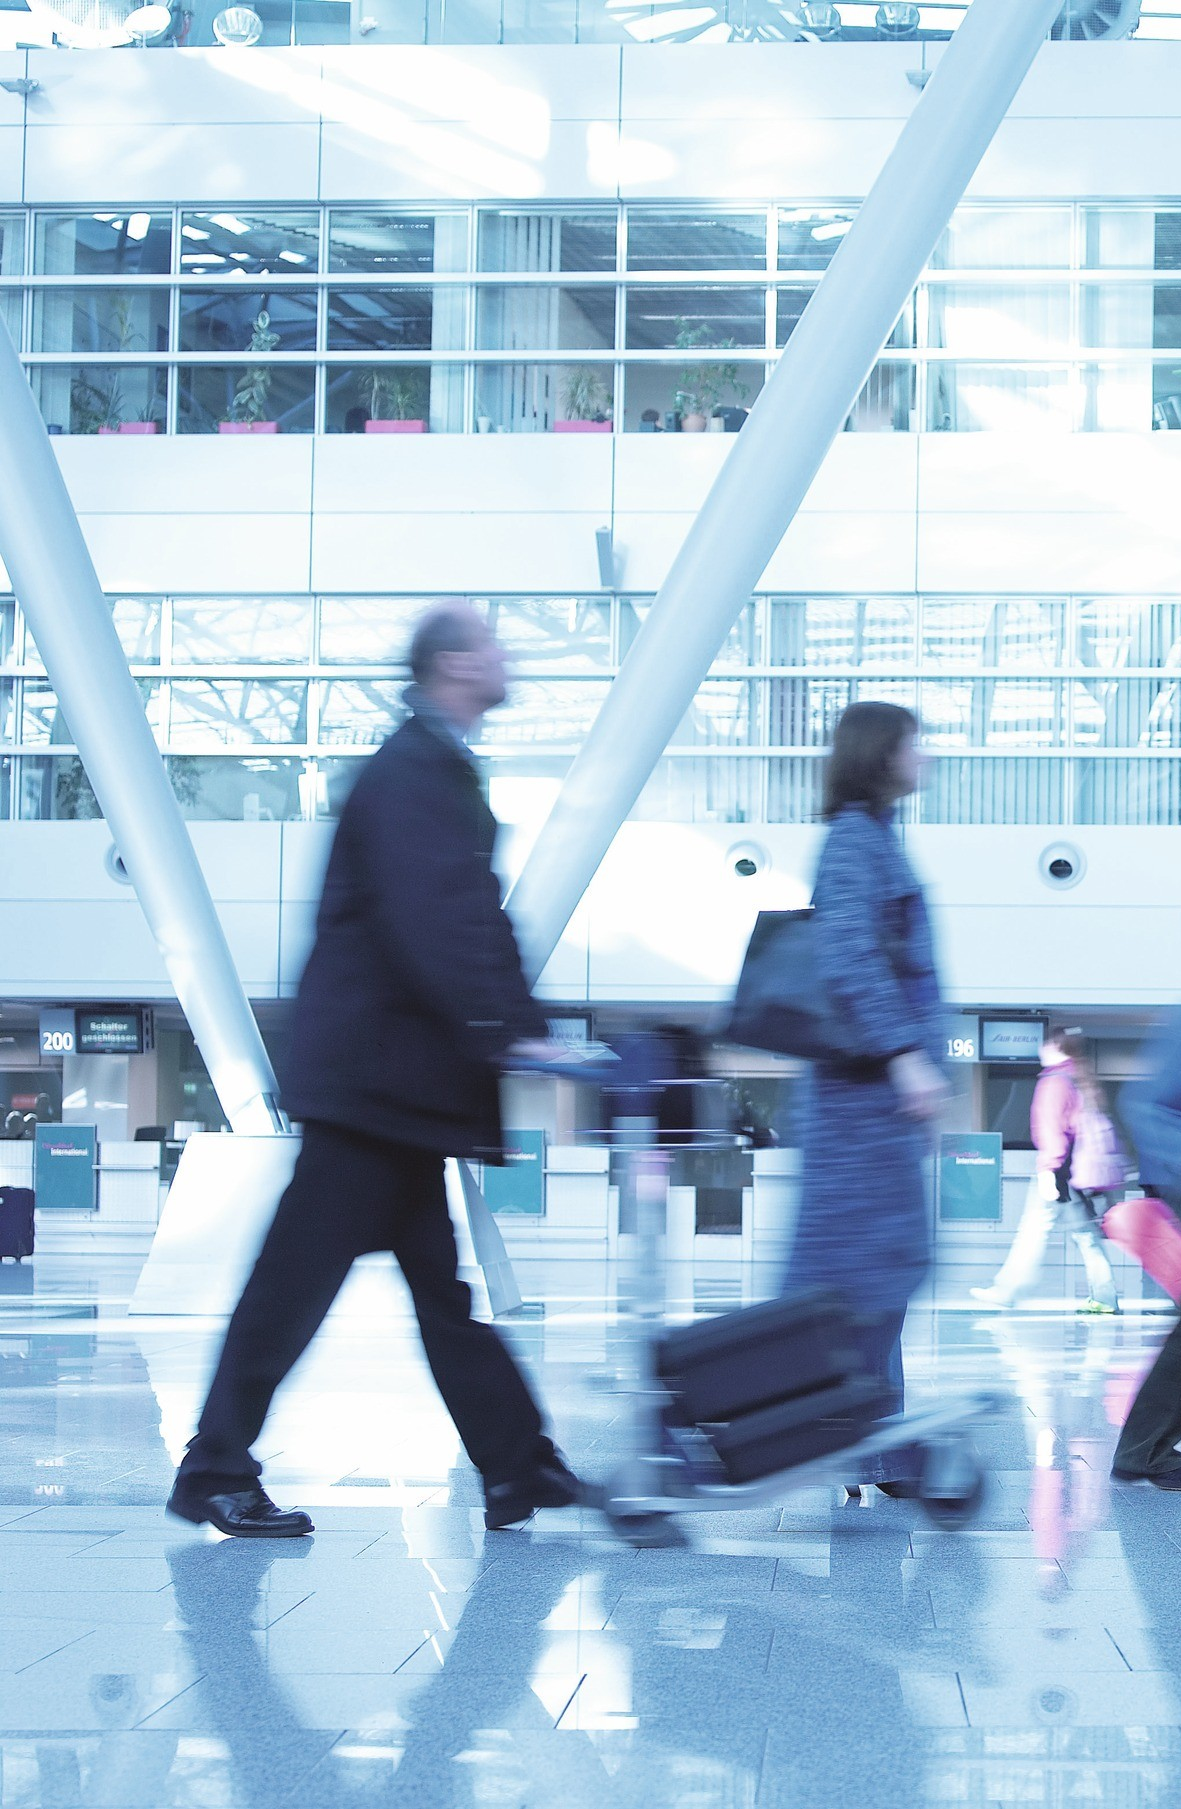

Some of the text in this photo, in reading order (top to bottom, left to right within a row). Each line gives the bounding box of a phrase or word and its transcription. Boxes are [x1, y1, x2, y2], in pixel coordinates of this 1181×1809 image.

[90, 1022, 128, 1031] Schalter
[43, 1032, 74, 1051] 200
[947, 1039, 975, 1057] 196
